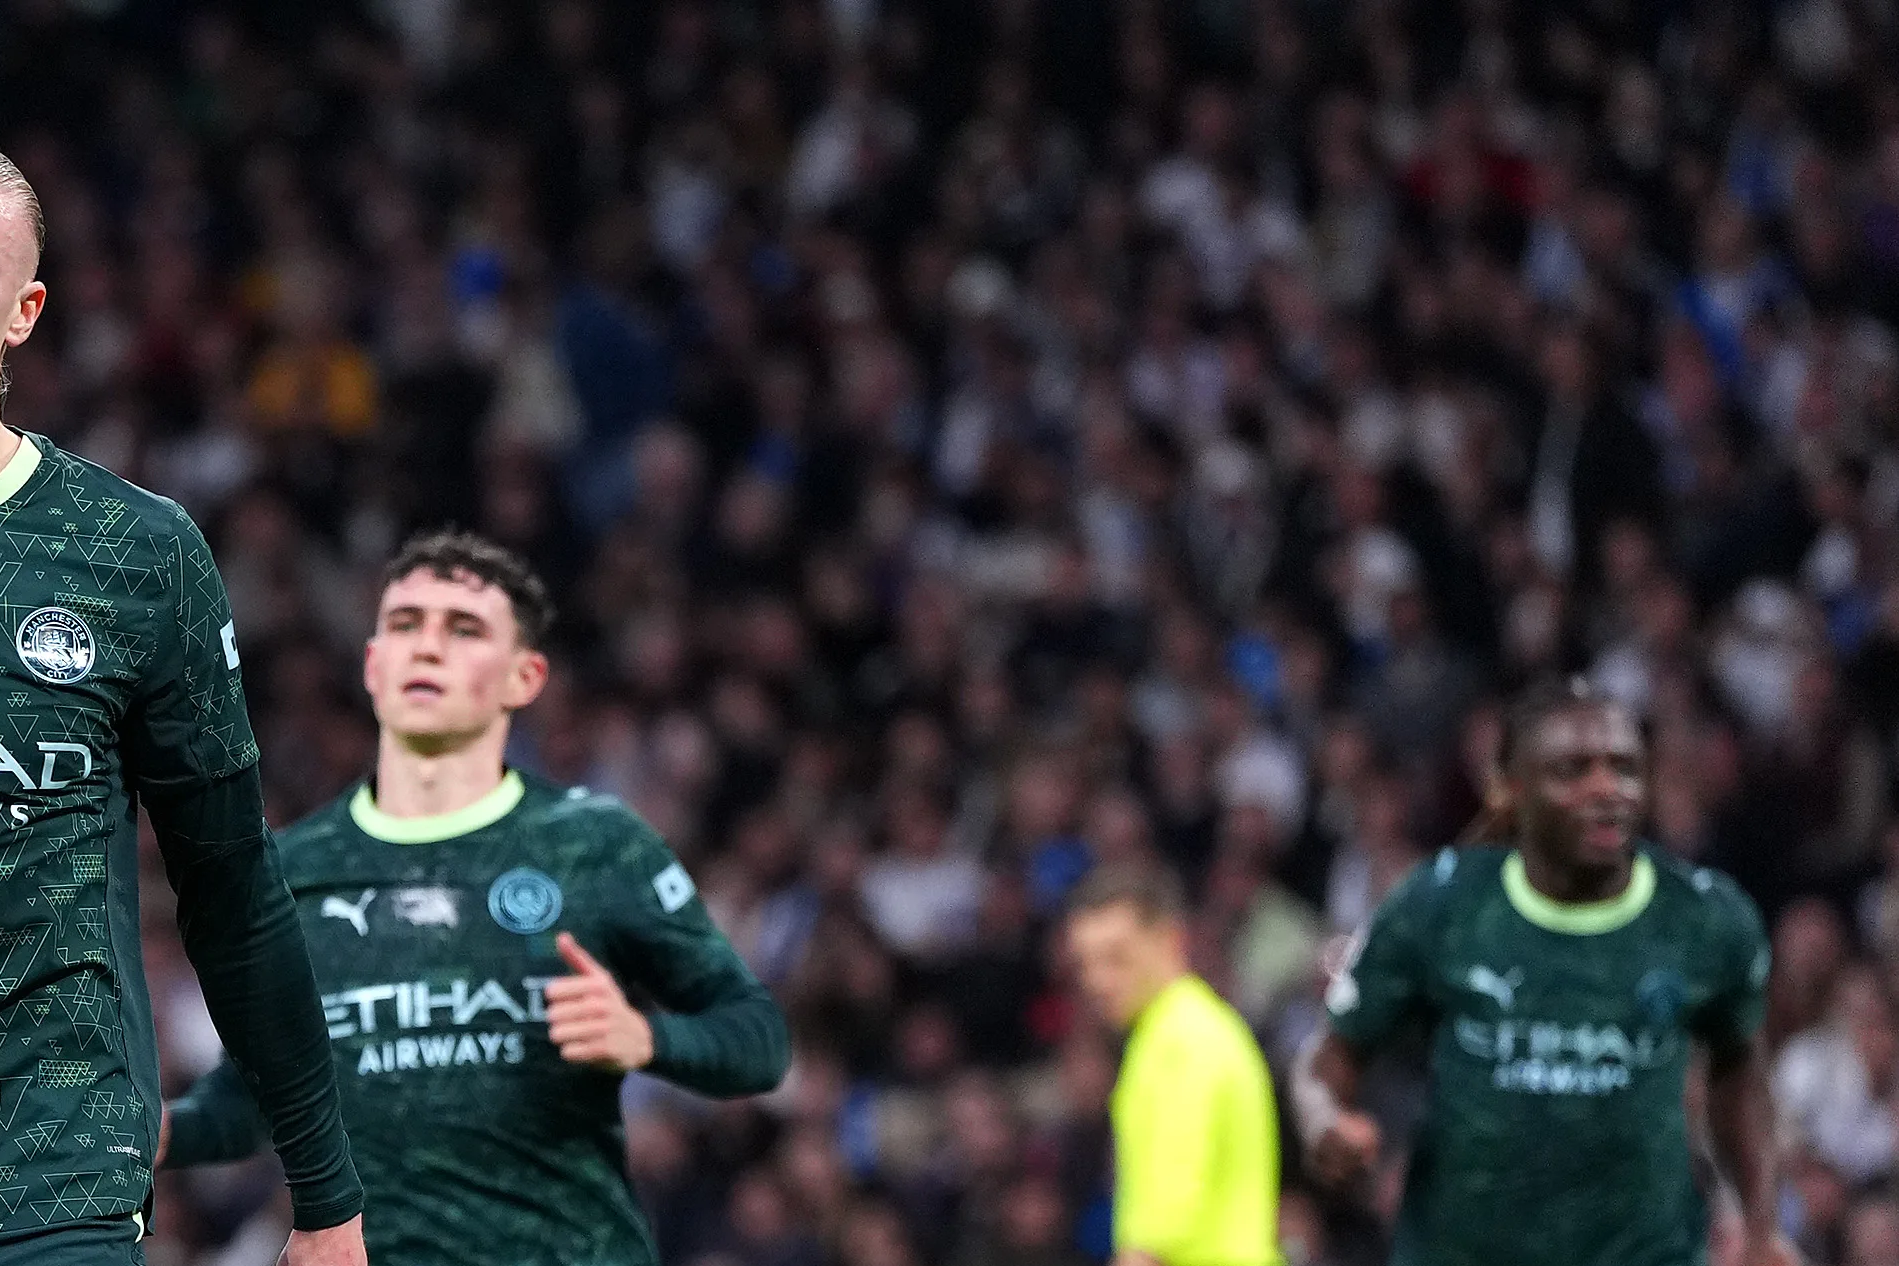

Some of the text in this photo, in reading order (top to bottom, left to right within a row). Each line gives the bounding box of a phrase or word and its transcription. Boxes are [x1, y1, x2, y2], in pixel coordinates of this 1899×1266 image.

[25, 612, 87, 641] MANCHESTER
[46, 669, 69, 680] CITY
[357, 1031, 526, 1076] AIRWAYS
